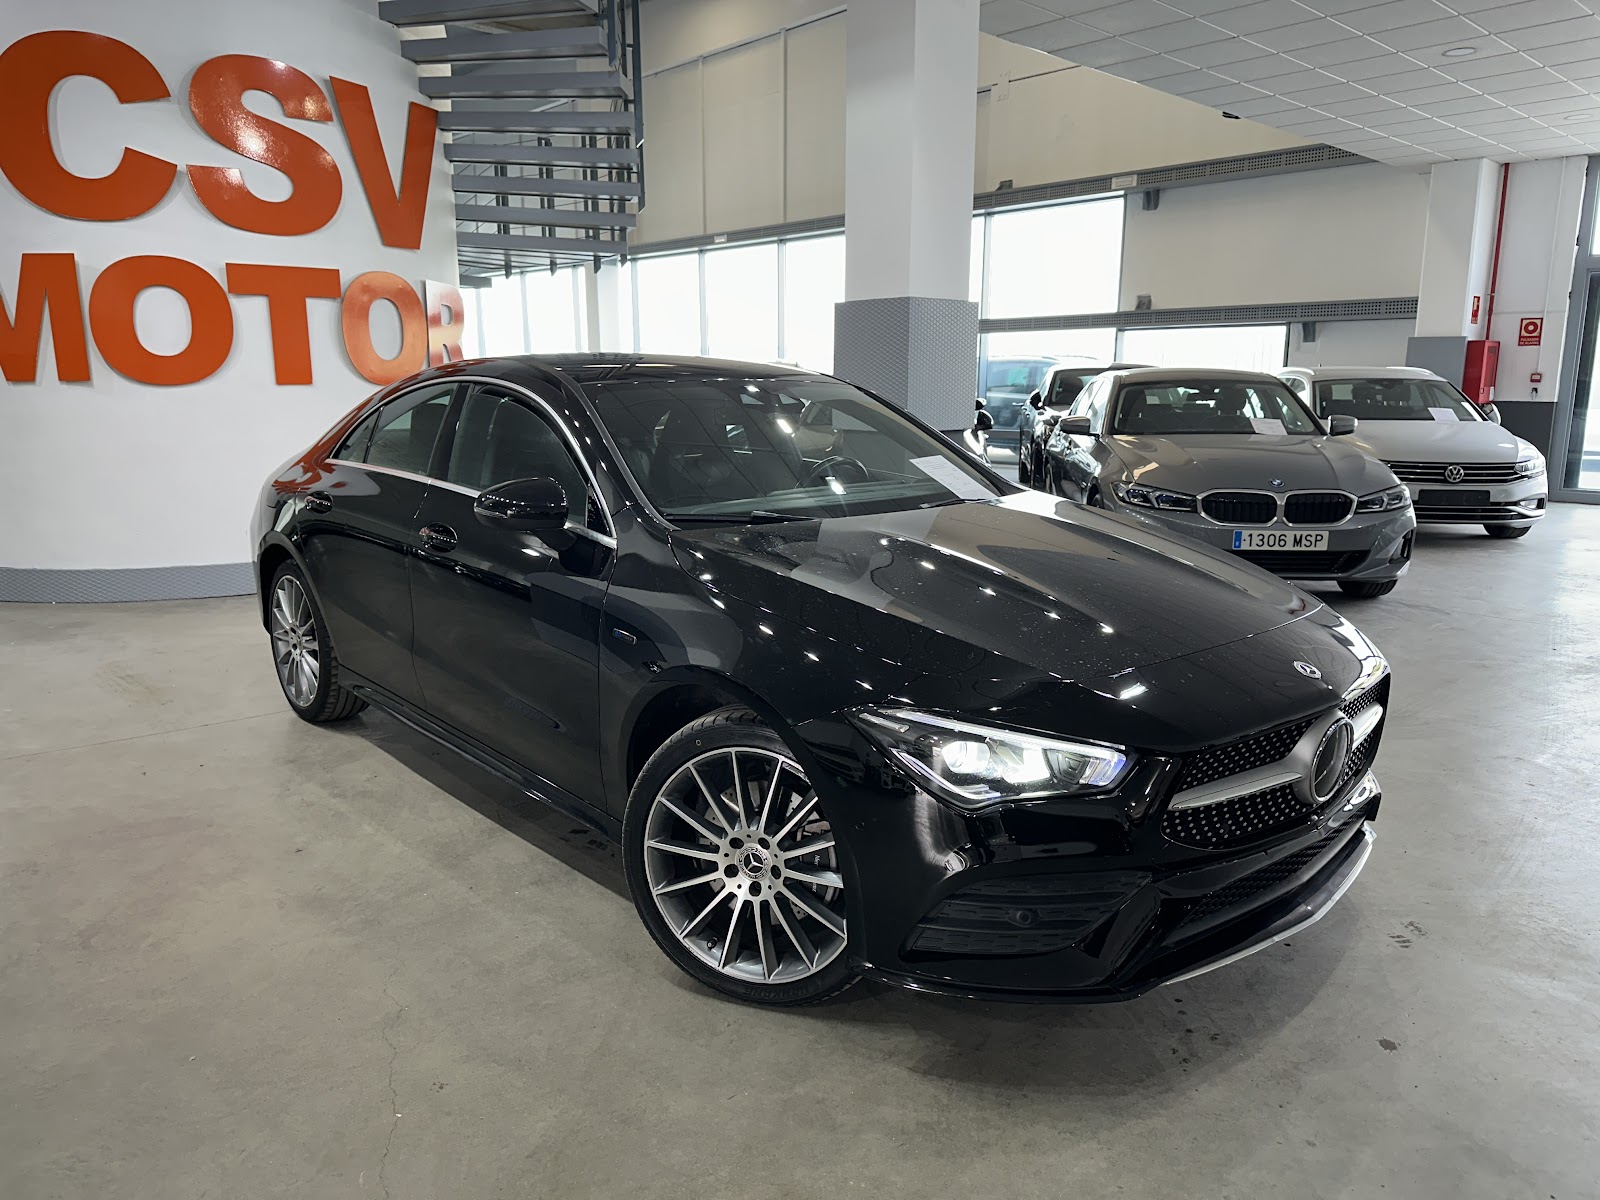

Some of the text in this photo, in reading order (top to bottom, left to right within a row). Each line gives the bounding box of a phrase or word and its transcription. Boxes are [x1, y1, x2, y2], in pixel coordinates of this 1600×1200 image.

[0, 30, 439, 250] CSV
[0, 252, 465, 386] MOTOR
[1247, 533, 1287, 548] 1306
[1292, 533, 1324, 548] MSP
